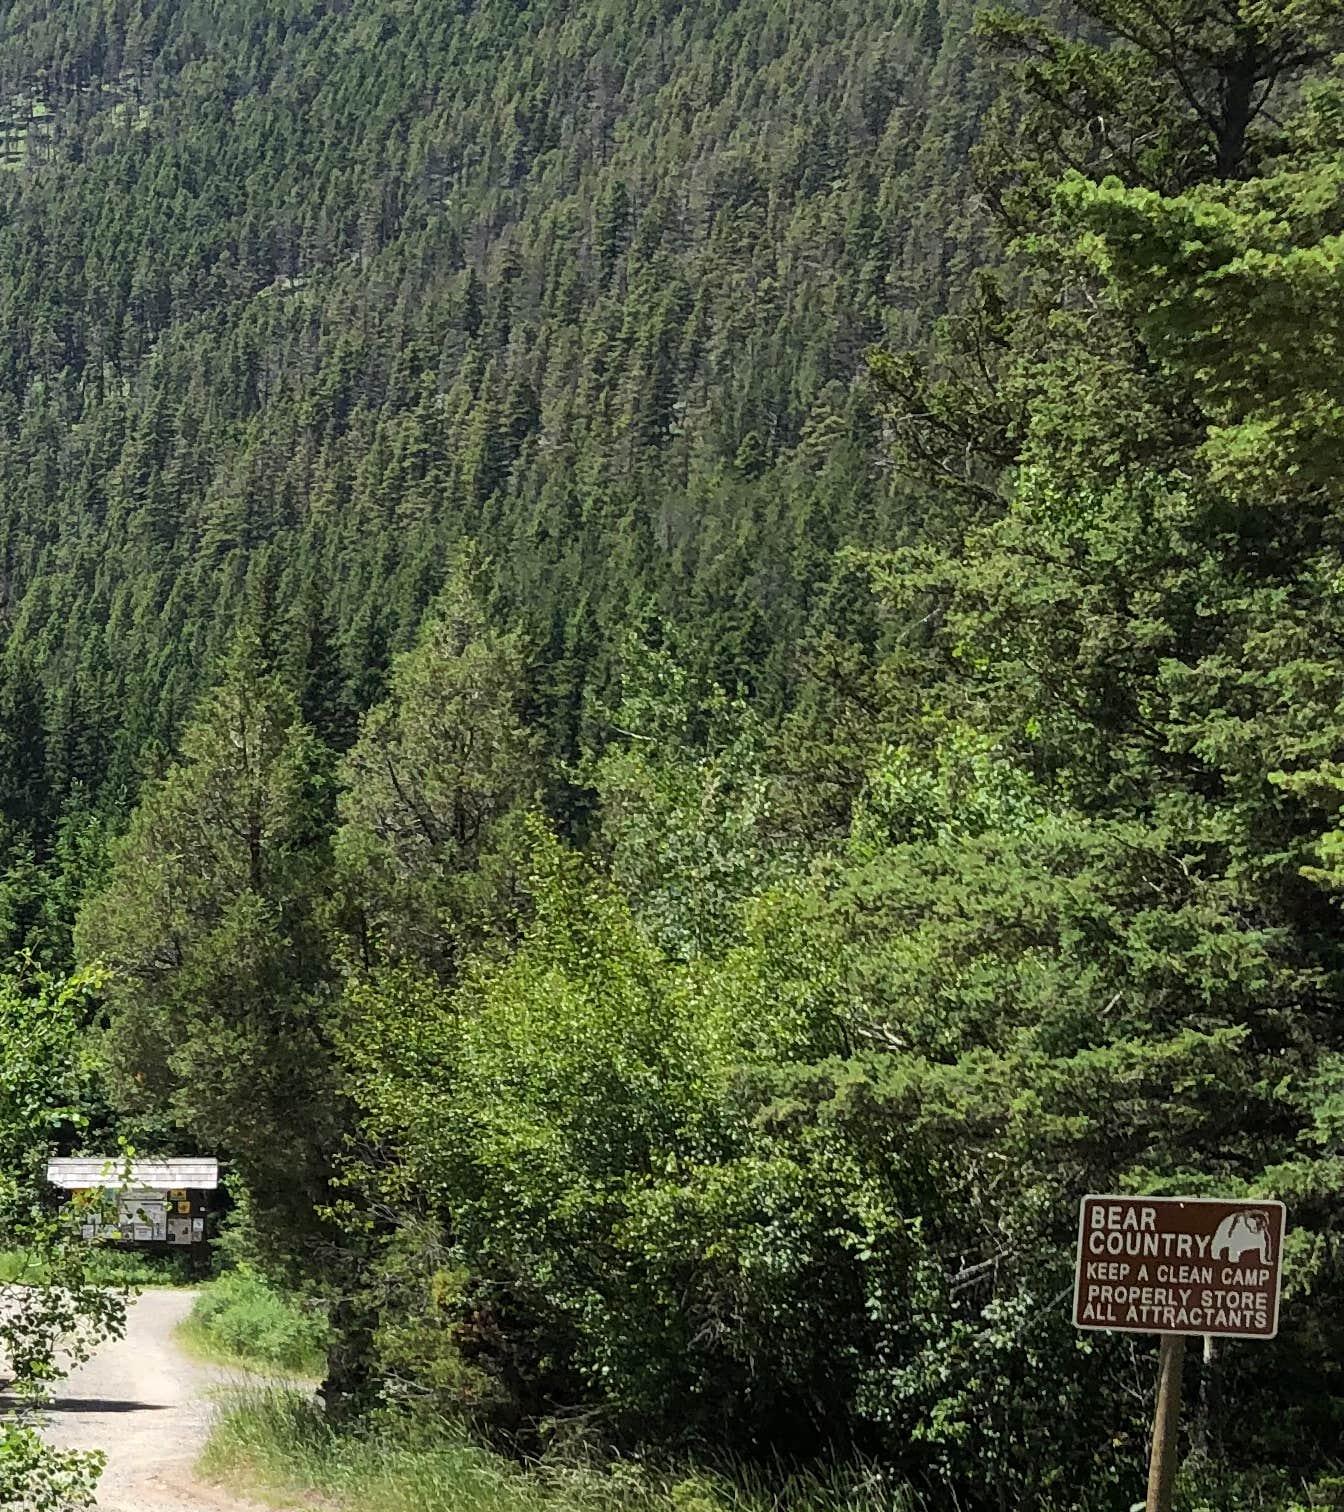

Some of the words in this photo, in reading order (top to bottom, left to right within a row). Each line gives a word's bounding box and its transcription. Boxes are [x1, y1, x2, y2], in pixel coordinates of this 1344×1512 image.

[1091, 1206, 1157, 1231] BEAR
[1089, 1231, 1210, 1258] COUNTRY
[1087, 1262, 1130, 1281] KEEP
[1138, 1265, 1149, 1281] A
[1157, 1265, 1212, 1284] CLEAN
[1221, 1268, 1270, 1286] CAMP
[1088, 1285, 1191, 1306] PROPERLY
[1201, 1290, 1268, 1310] STORE
[1083, 1303, 1116, 1321] ALL
[1126, 1305, 1267, 1328] ATTRACTANTS
